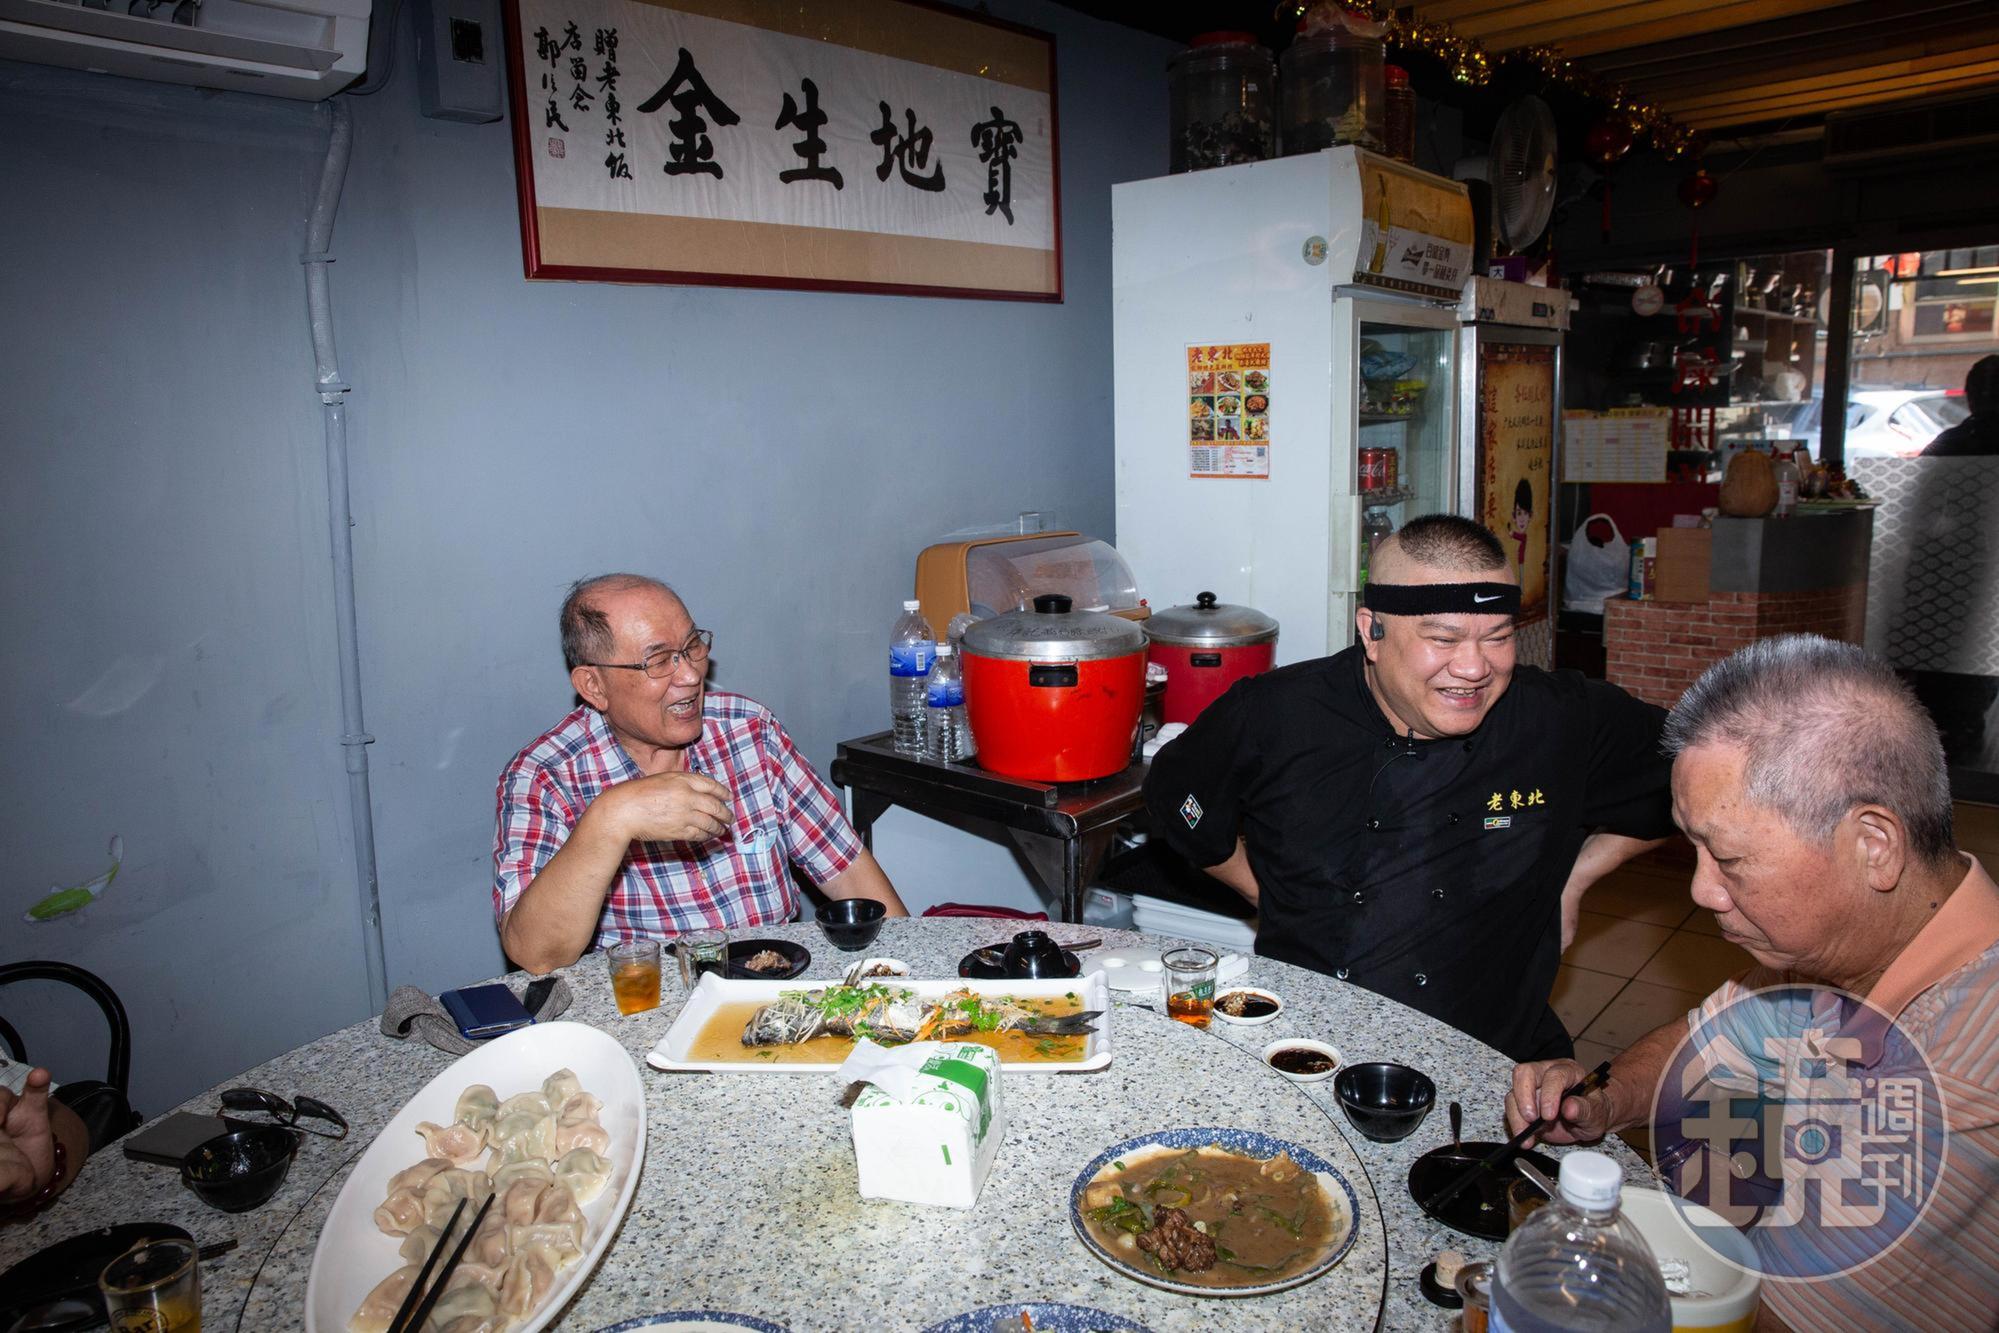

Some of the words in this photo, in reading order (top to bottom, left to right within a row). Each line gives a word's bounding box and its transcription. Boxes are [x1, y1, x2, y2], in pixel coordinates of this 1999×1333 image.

[1191, 346, 1233, 363] 老東北
[1486, 787, 1546, 812] 老東北
